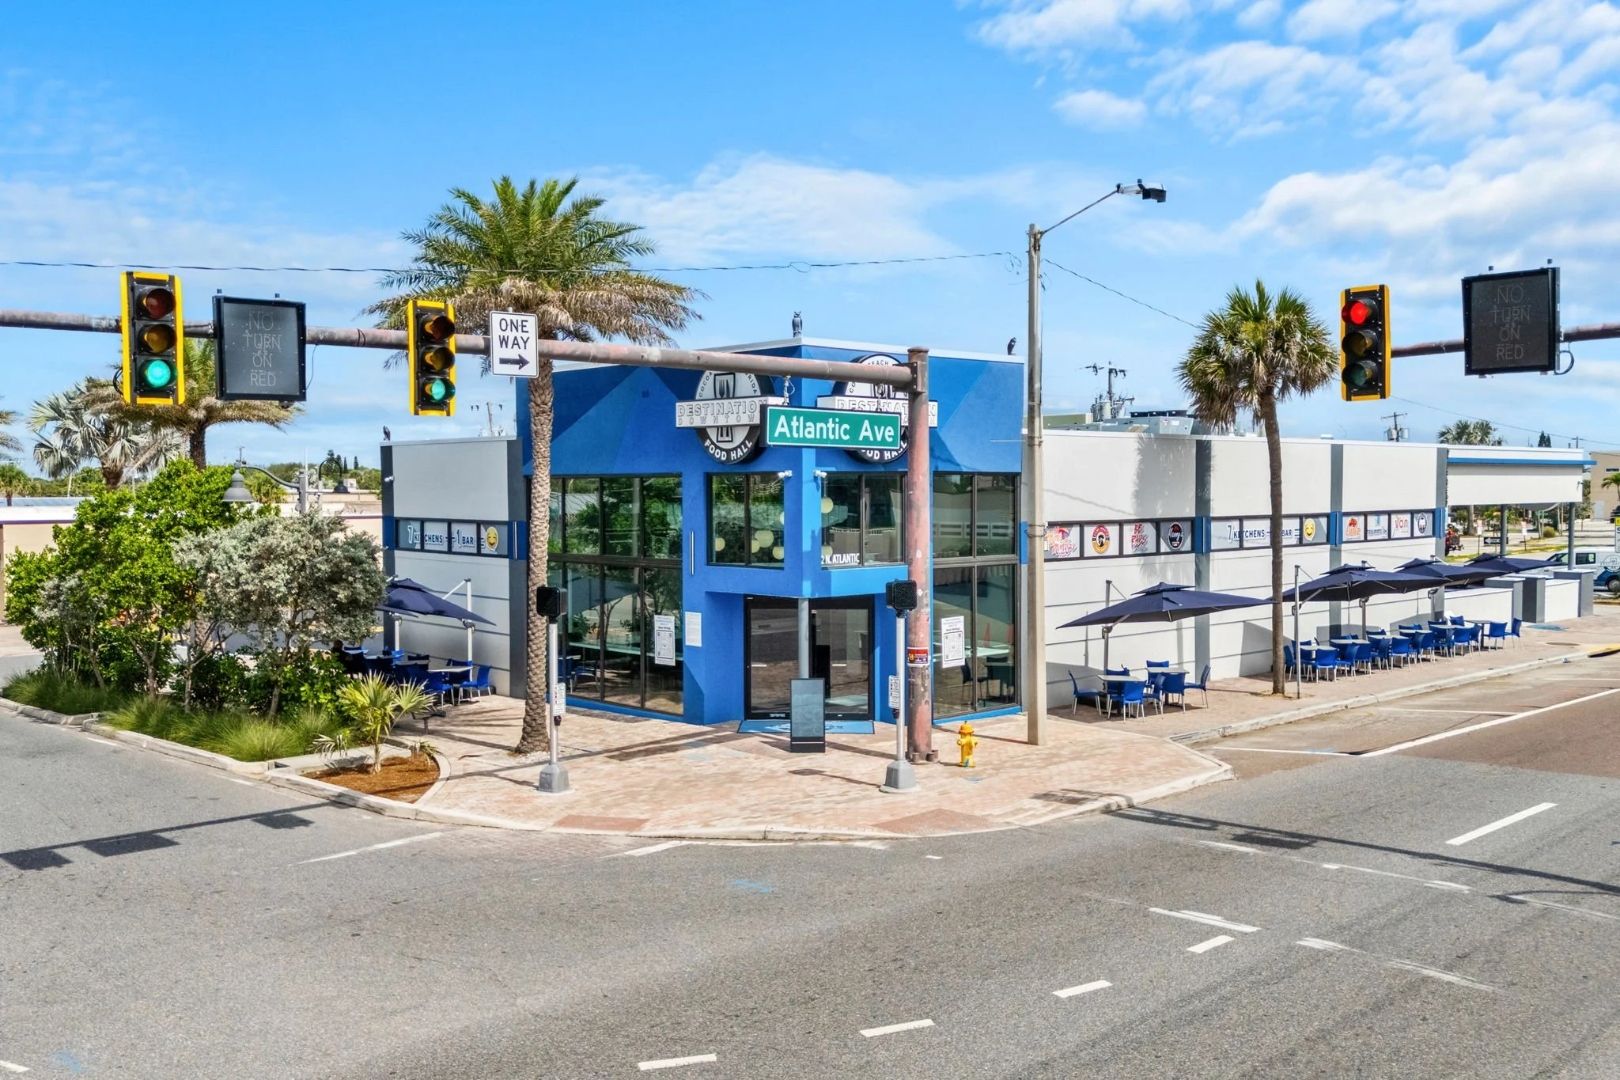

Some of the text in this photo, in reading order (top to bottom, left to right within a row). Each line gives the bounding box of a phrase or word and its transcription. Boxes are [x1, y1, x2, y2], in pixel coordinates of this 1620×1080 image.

[1496, 286, 1524, 304] NO
[248, 310, 274, 330] NO
[1490, 305, 1531, 323] TURN
[499, 318, 529, 333] ONE
[1499, 327, 1520, 341] ON
[243, 333, 281, 351] TURN
[498, 335, 530, 350] WAY
[1496, 345, 1524, 360] RED
[252, 353, 272, 368] ON
[250, 371, 276, 387] RED
[774, 415, 850, 440] Atlantic
[859, 419, 894, 442] Ave
[704, 439, 753, 461] FOOD HALL
[462, 536, 474, 545] BAR
[833, 553, 860, 564] ATLANTIC
